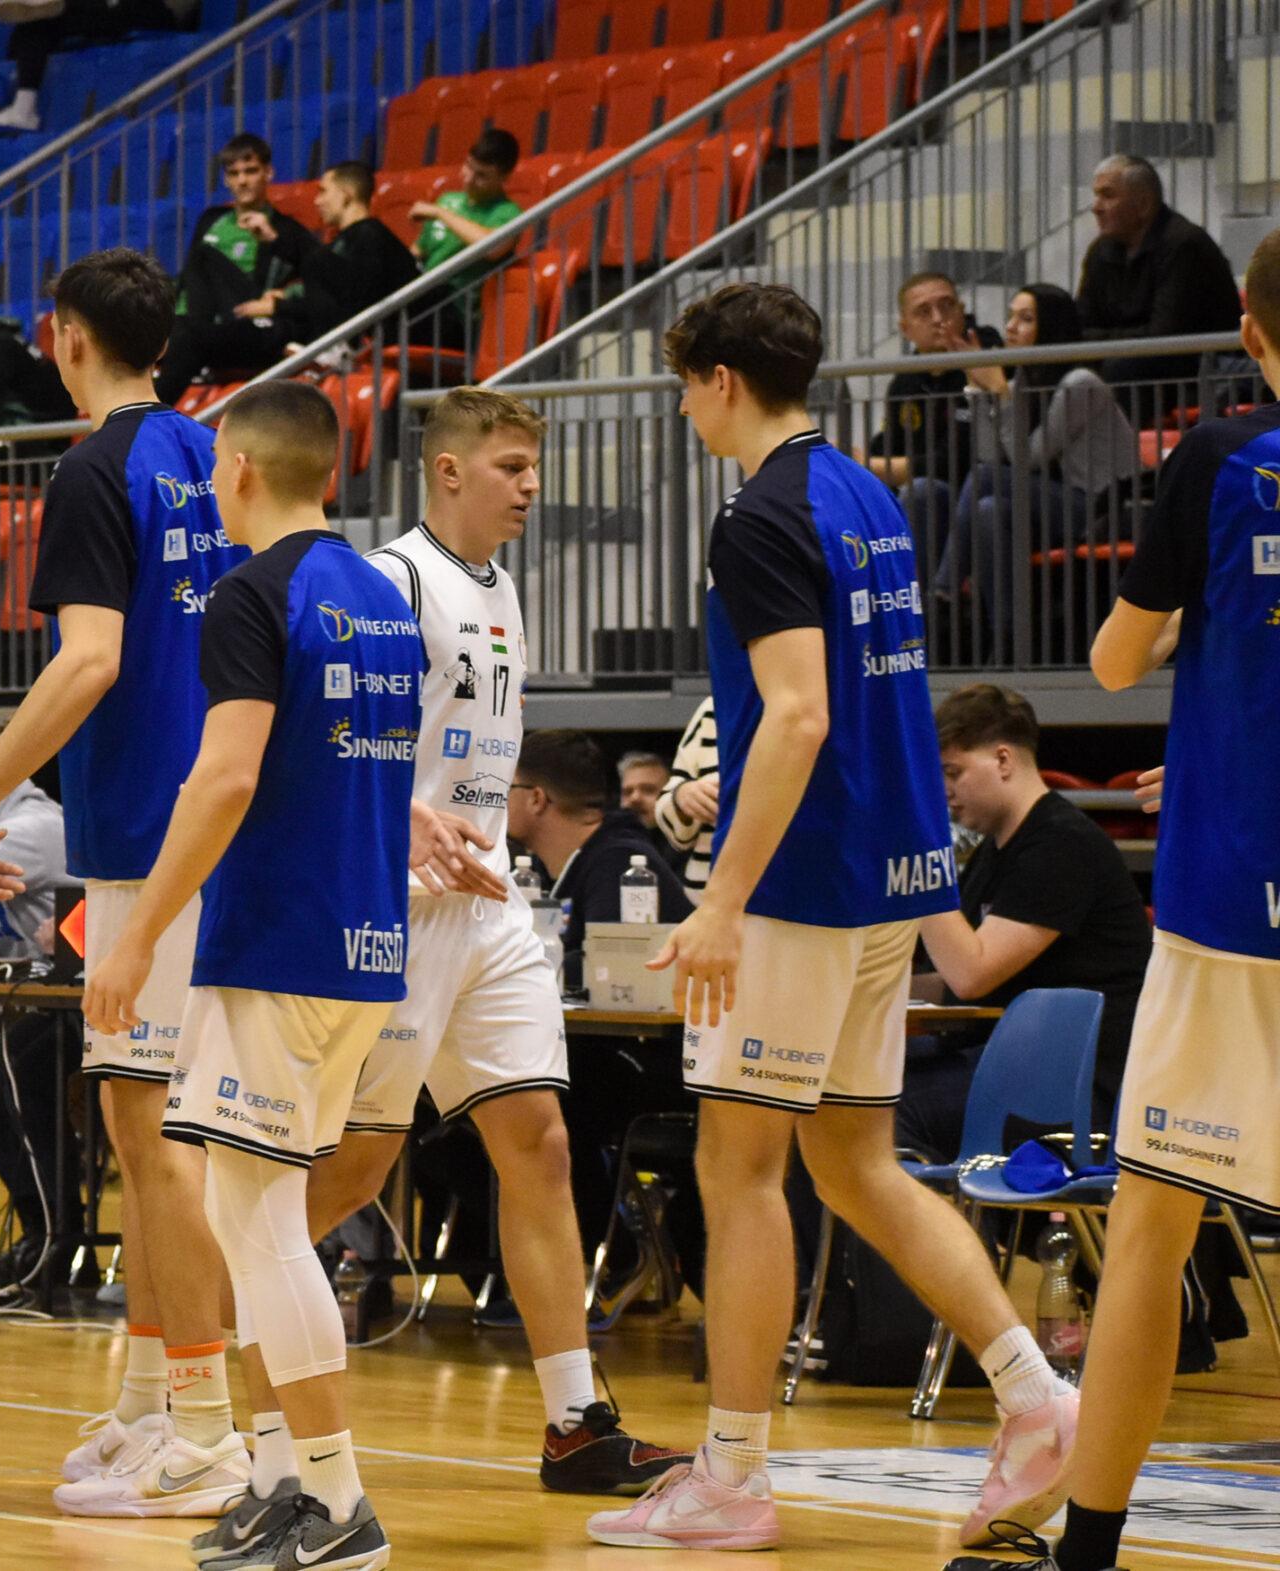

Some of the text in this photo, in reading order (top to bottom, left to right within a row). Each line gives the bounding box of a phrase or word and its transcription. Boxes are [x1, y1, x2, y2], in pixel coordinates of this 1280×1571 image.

[458, 622, 480, 634] JAKO
[492, 663, 510, 717] 17
[343, 921, 404, 974] VÉGSŐ
[379, 1028, 418, 1041] BNER
[130, 1048, 175, 1059] 99.4 SUNS
[769, 1047, 826, 1065] HÜBNER
[740, 1066, 820, 1087] 99.4 SUNSHINE FM
[242, 1092, 296, 1114] ÜBNER
[216, 1106, 238, 1121] 99.4
[273, 1125, 290, 1138] FM
[1173, 1116, 1239, 1142] HÜBNER
[1146, 1138, 1236, 1168] 99.4 SUNSHINE FM
